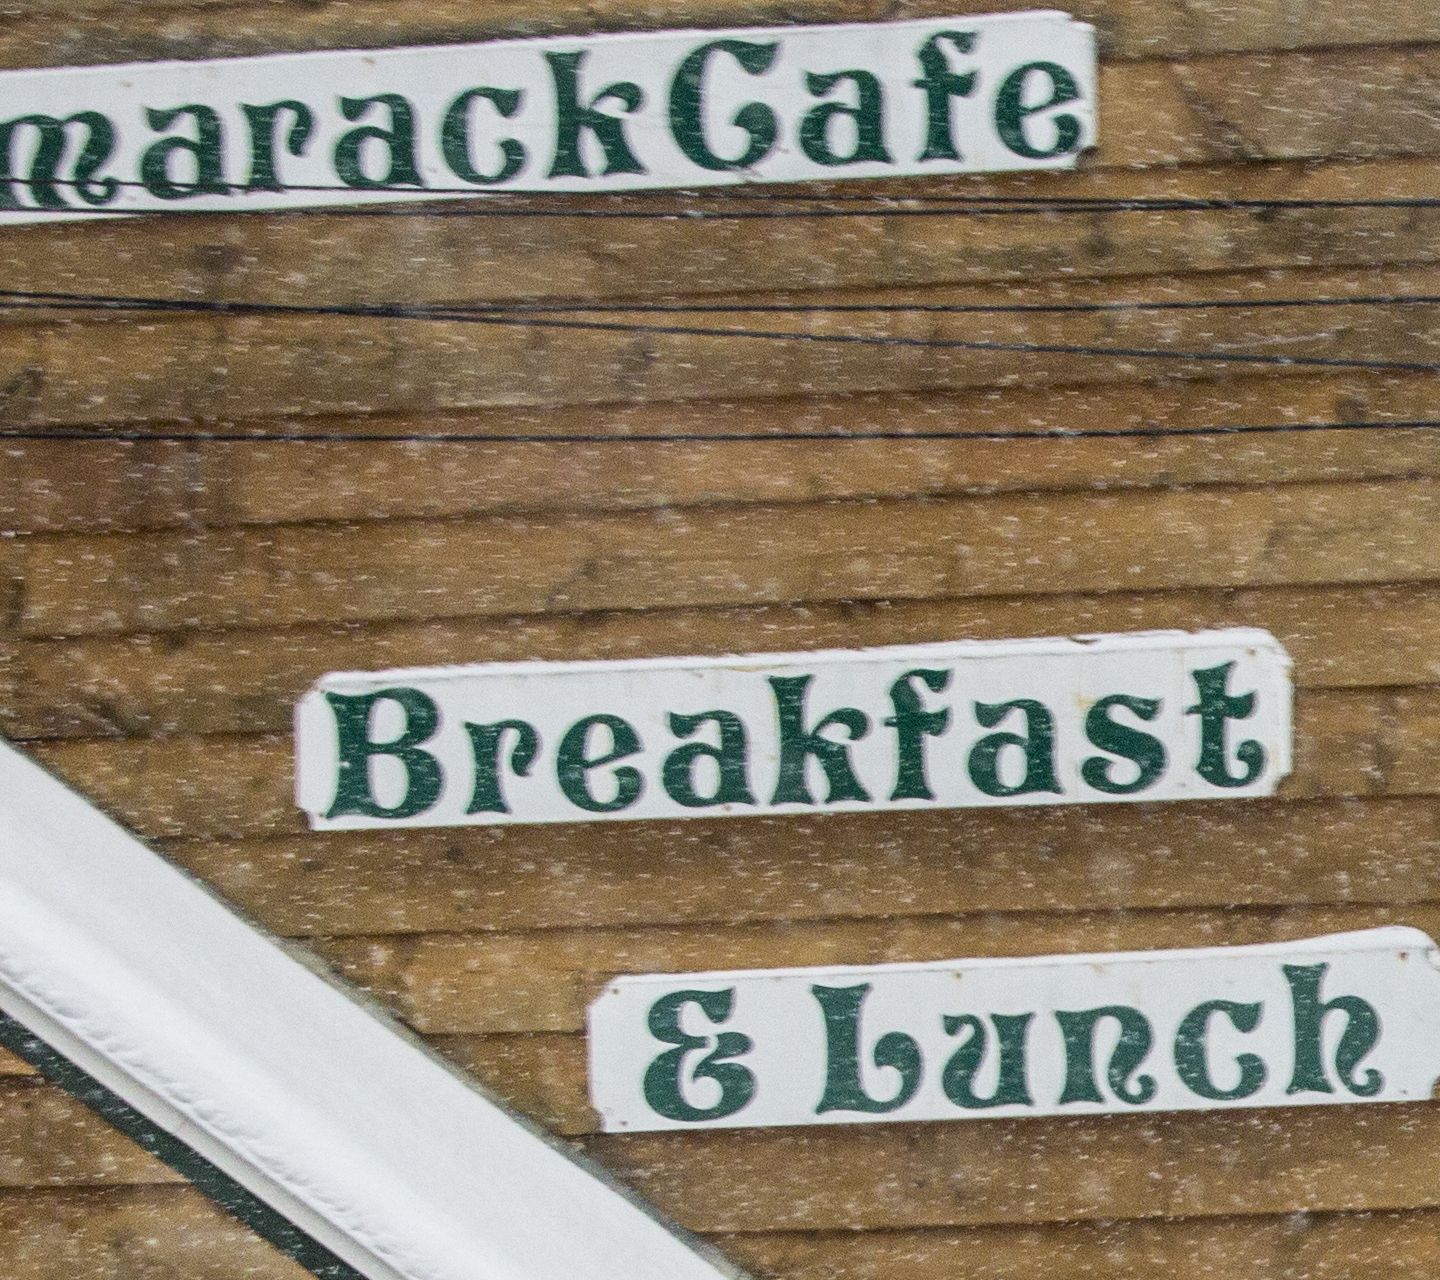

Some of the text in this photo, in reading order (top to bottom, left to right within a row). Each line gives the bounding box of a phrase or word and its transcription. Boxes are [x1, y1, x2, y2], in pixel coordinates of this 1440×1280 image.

[321, 660, 1266, 820] Breakfast
[643, 962, 1384, 1122] & Lunch
